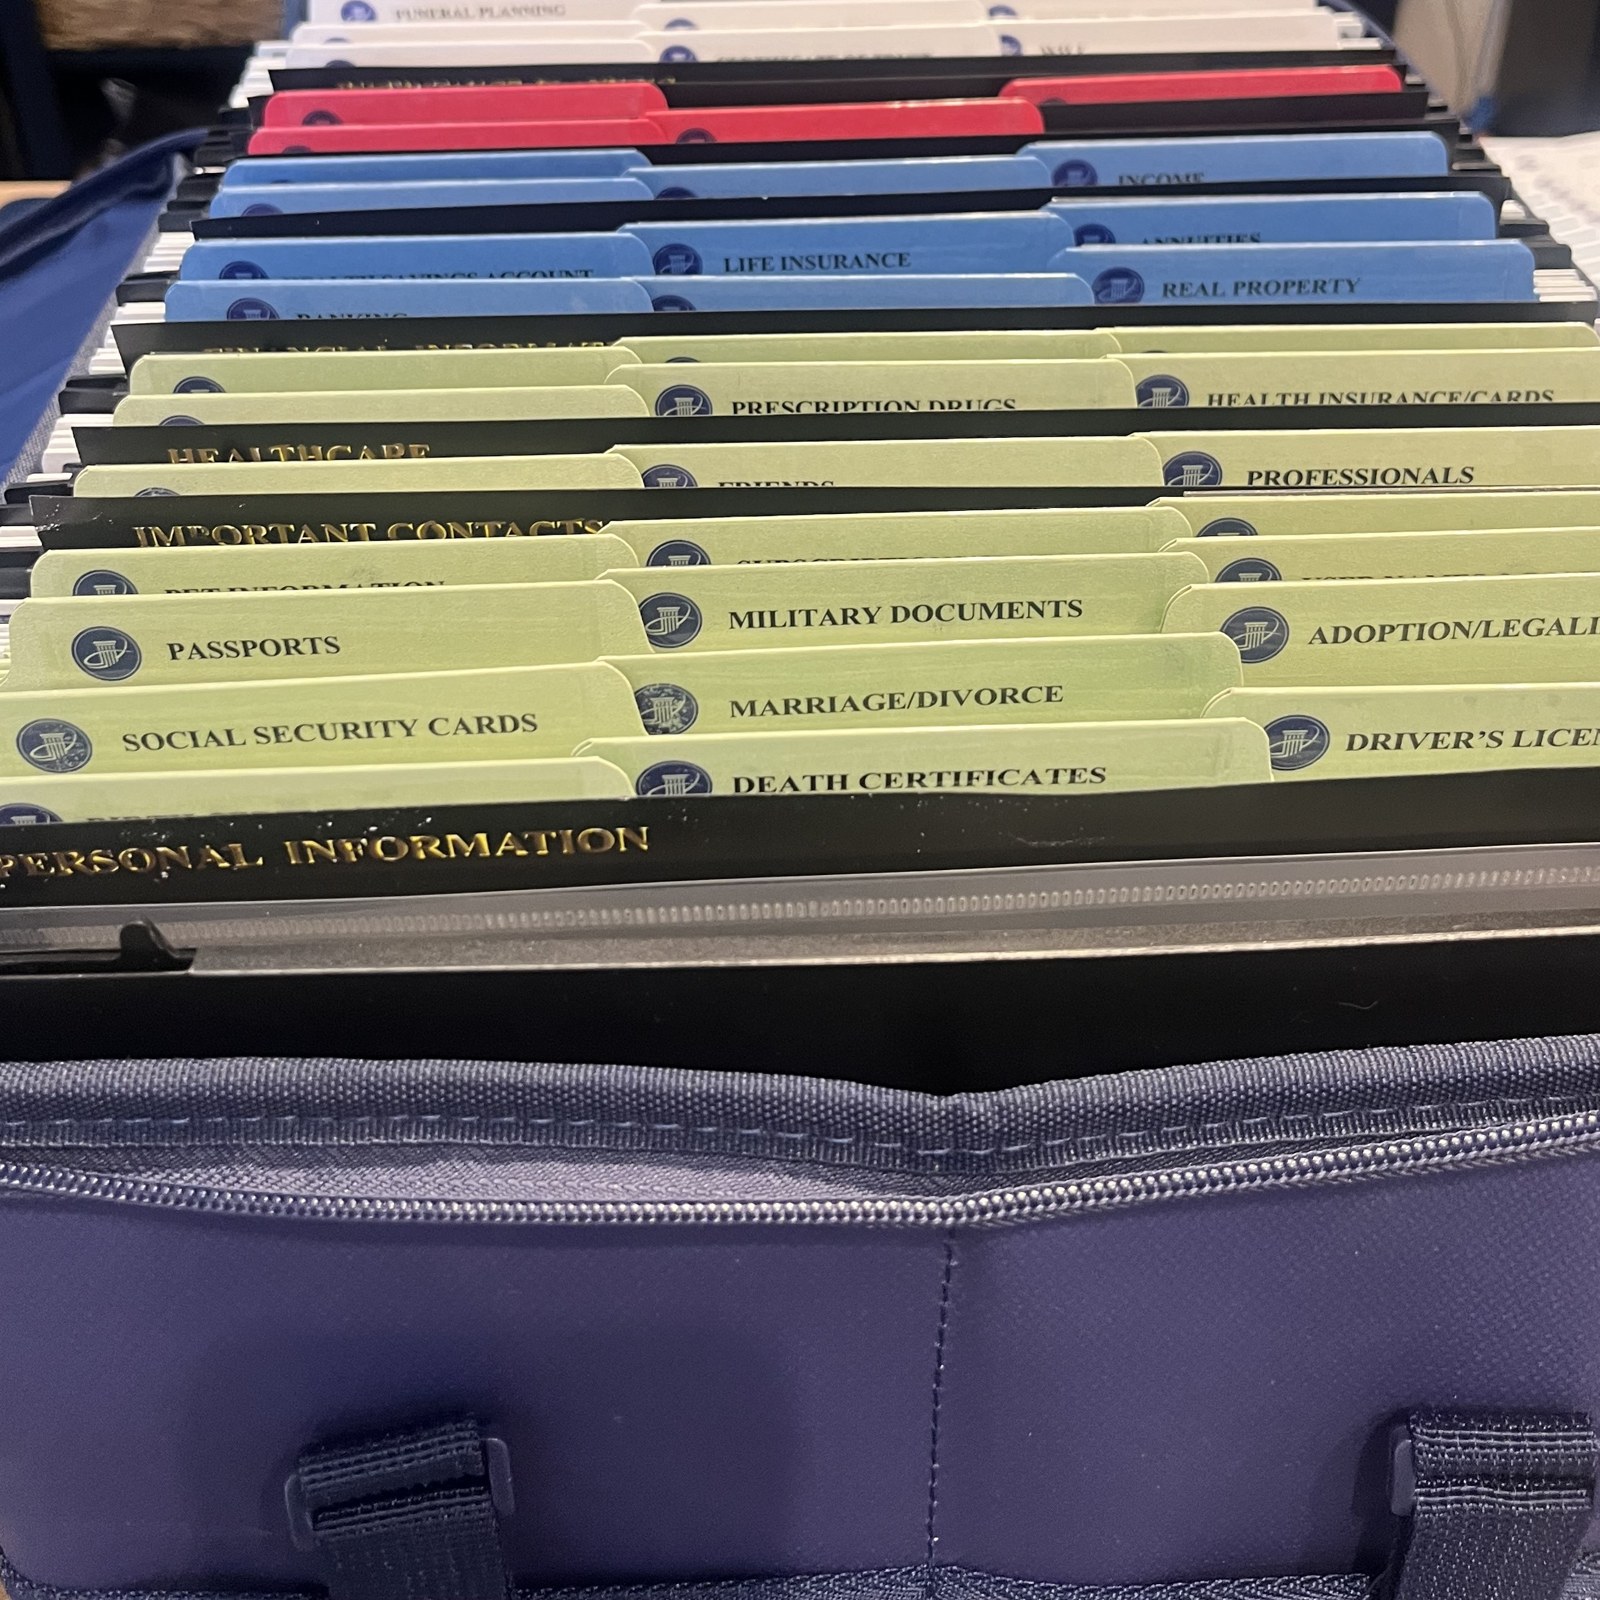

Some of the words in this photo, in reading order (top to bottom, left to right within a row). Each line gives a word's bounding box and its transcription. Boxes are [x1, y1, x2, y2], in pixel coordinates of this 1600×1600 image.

[724, 255, 774, 272] LIFE
[781, 252, 912, 272] INSURANCE
[1162, 281, 1225, 298] REAL
[1233, 278, 1361, 297] PROPERTY
[1247, 466, 1475, 486] PROFESSIONALS
[132, 522, 378, 548] IMPORTANT
[729, 606, 882, 629] MILITARY
[890, 600, 1083, 624] DOCUMENTS
[166, 636, 341, 660] PASSPORTS
[729, 685, 1064, 718] MARRIAGE/DIVORCE
[122, 728, 246, 752] SOCIAL
[254, 719, 419, 745] SECURITY
[428, 713, 538, 737] CARDS
[1346, 729, 1504, 751] DRIVER'S
[732, 773, 849, 794] DEATH
[858, 766, 1107, 789] CERTIFICATES
[0, 843, 264, 878] PERSONAL
[284, 826, 649, 864] INFORMATION
